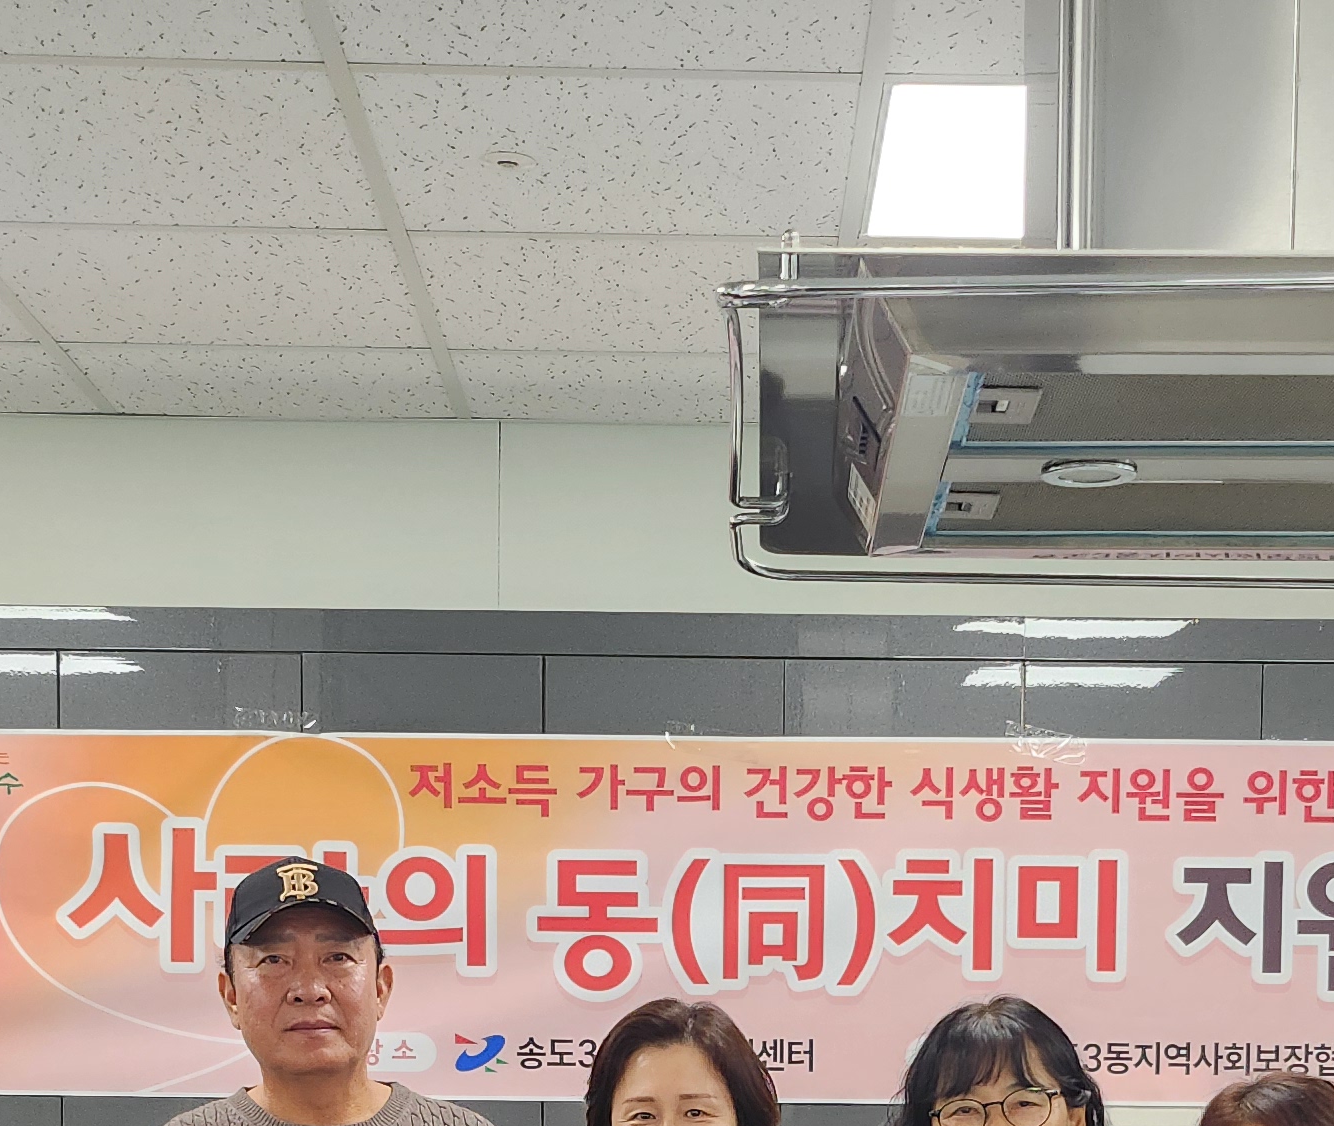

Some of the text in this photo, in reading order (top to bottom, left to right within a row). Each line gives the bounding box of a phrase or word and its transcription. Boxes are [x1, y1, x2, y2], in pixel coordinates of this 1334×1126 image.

[408, 762, 558, 818] 저소득
[577, 764, 723, 813] 가구의
[744, 765, 894, 821] 건강한
[912, 766, 1059, 822] 식생활
[1079, 767, 1225, 823] 지원을
[66, 827, 487, 967] 사의
[536, 857, 1120, 993] 동(同)치미
